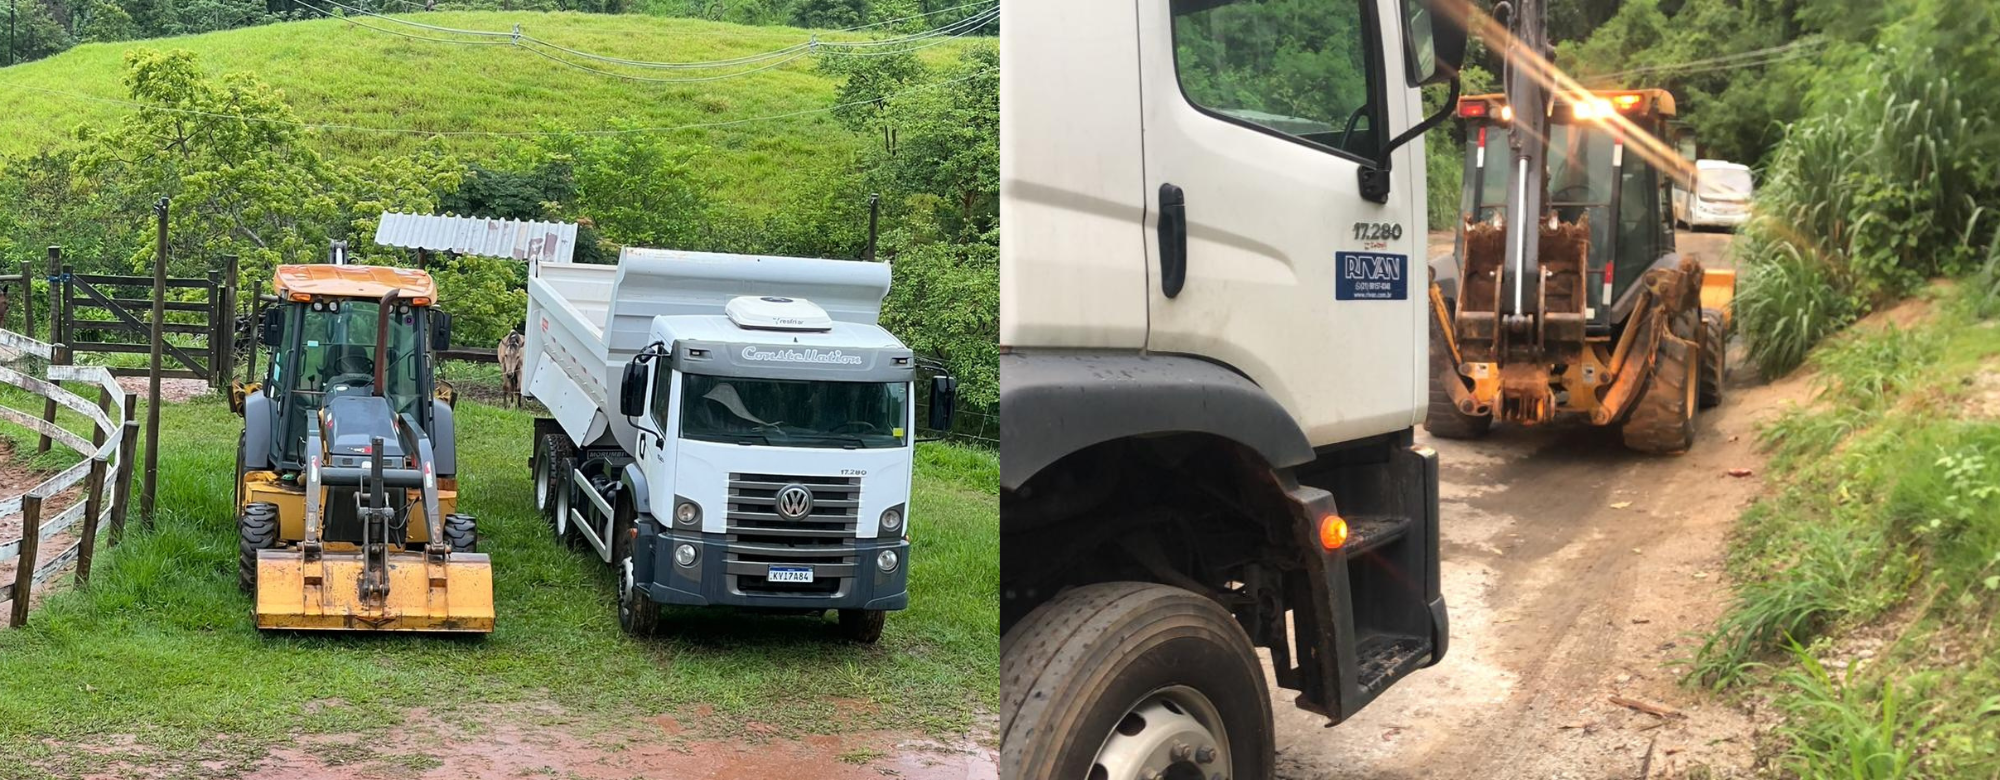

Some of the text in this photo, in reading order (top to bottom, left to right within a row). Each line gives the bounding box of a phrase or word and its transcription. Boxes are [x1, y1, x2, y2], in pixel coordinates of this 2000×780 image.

[1353, 222, 1402, 240] 17.280
[1345, 255, 1400, 280] RIVAN
[741, 345, 862, 364] Constellation
